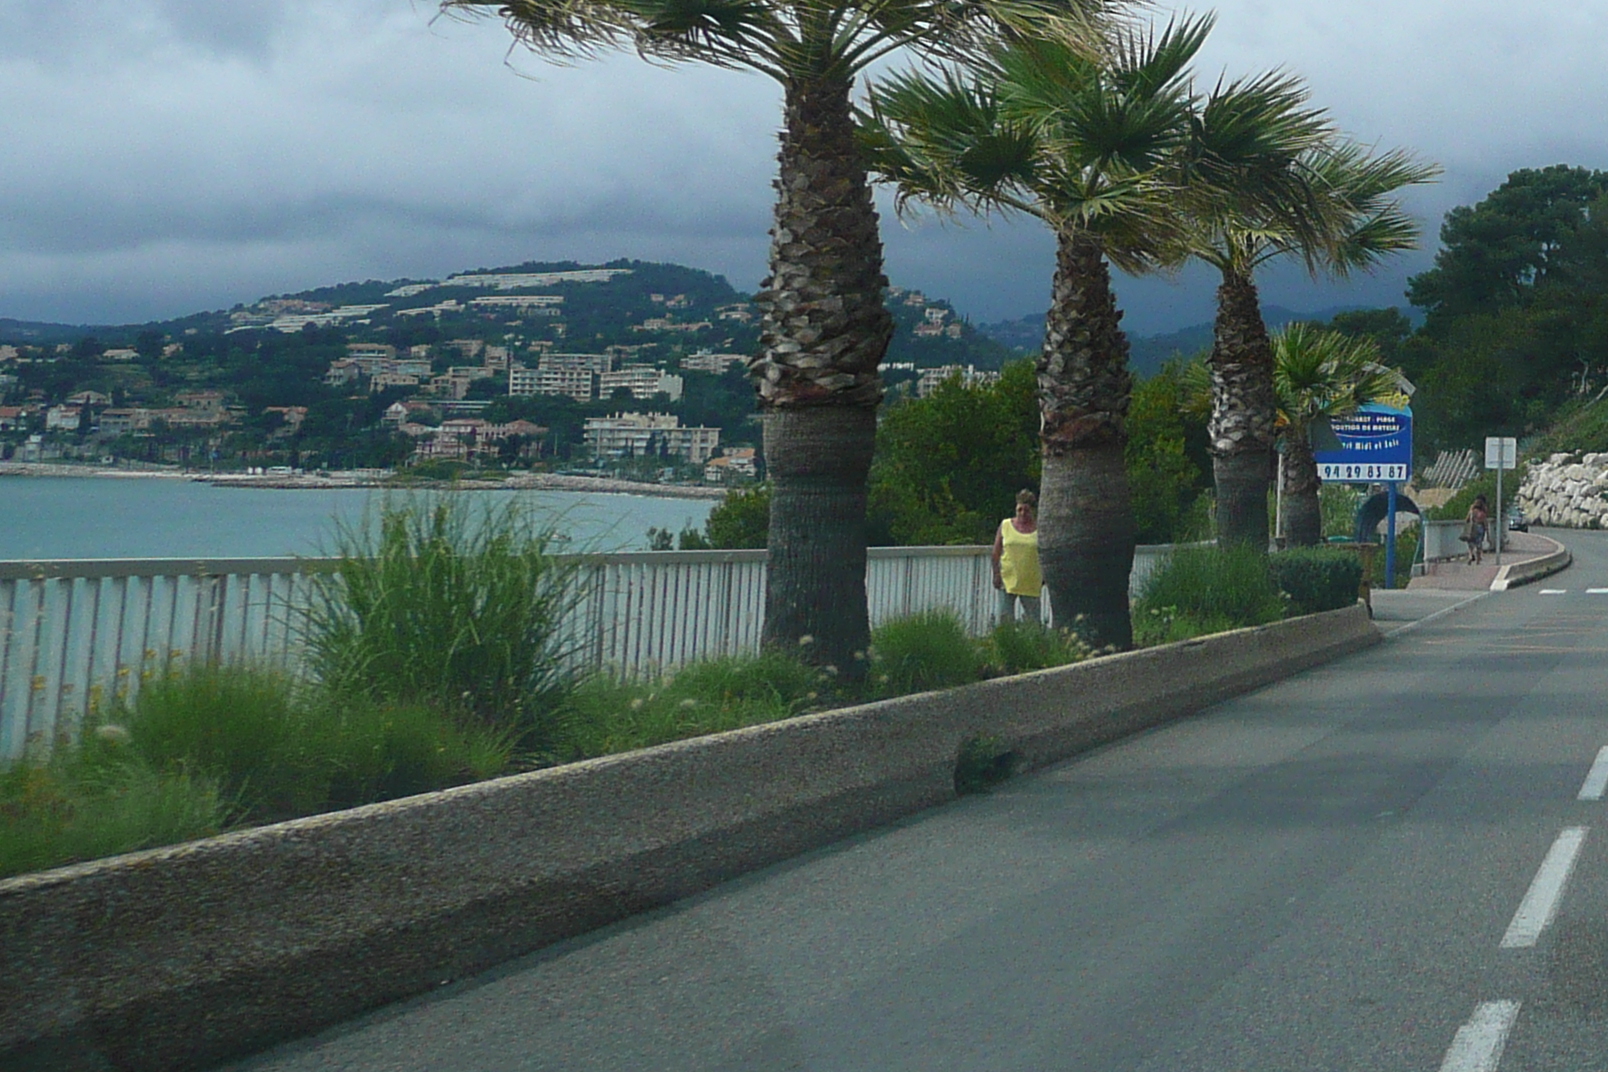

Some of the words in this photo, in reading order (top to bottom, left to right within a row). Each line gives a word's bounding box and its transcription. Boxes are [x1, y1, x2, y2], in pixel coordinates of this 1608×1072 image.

[1355, 441, 1372, 450] Midi
[1324, 465, 1340, 478] 94
[1346, 465, 1361, 478] 29
[1388, 465, 1404, 478] 87
